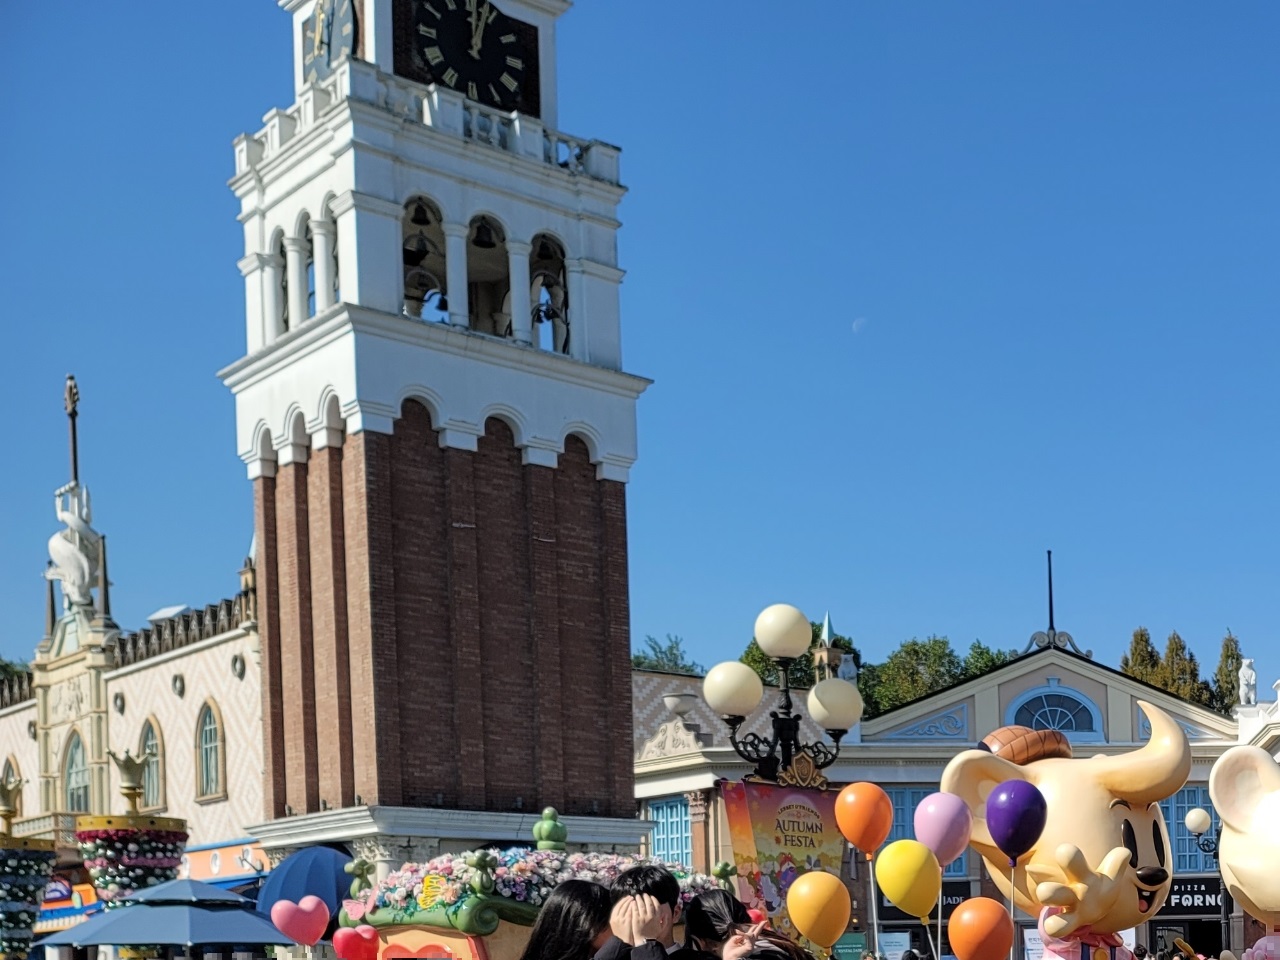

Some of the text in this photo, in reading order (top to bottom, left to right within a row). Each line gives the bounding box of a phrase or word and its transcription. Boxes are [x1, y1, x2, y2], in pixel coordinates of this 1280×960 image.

[775, 818, 823, 835] AUTUMN
[784, 834, 816, 848] FESTA
[1173, 884, 1206, 892] PIZZA
